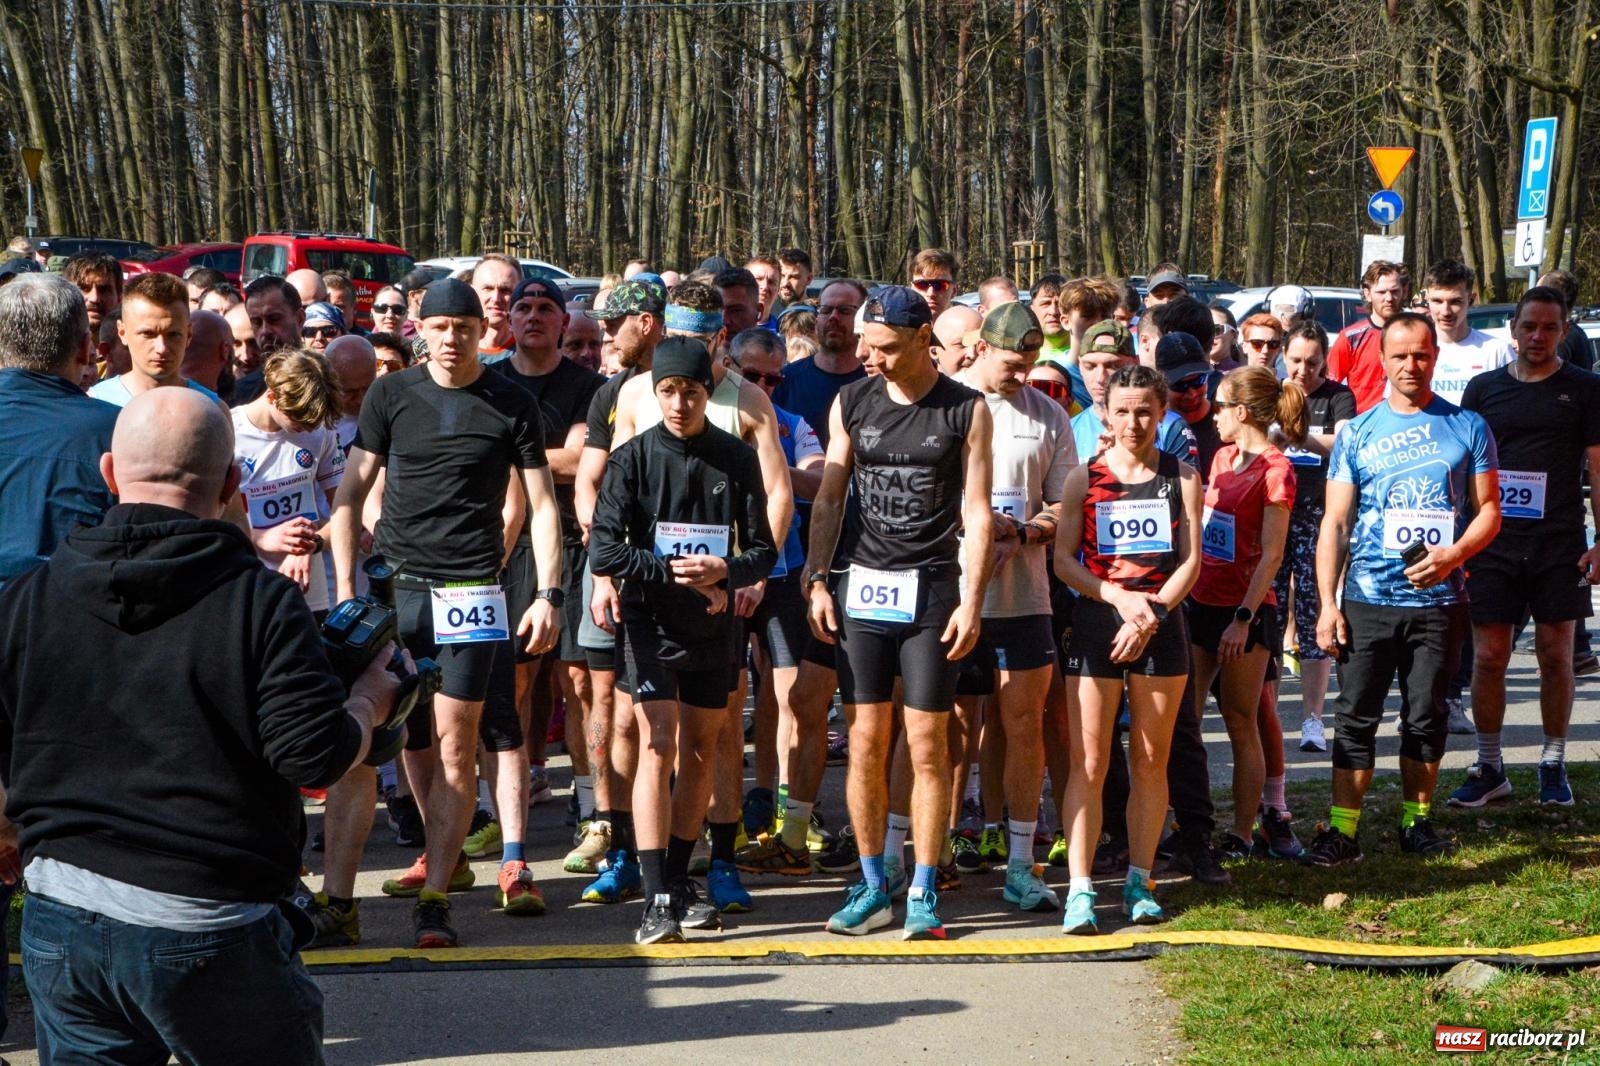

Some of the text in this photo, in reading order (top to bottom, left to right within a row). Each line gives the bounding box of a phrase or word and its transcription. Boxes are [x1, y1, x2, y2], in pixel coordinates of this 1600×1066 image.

[1526, 128, 1547, 189] P
[1360, 422, 1432, 466] MORSY
[1366, 440, 1442, 476] RACIBÓRZ
[263, 491, 303, 519] 037
[870, 493, 926, 519] BIEG
[1109, 518, 1158, 539] 090
[1204, 525, 1226, 547] 063
[1396, 526, 1441, 546] 030
[860, 584, 899, 607] 051
[447, 605, 496, 628] 043
